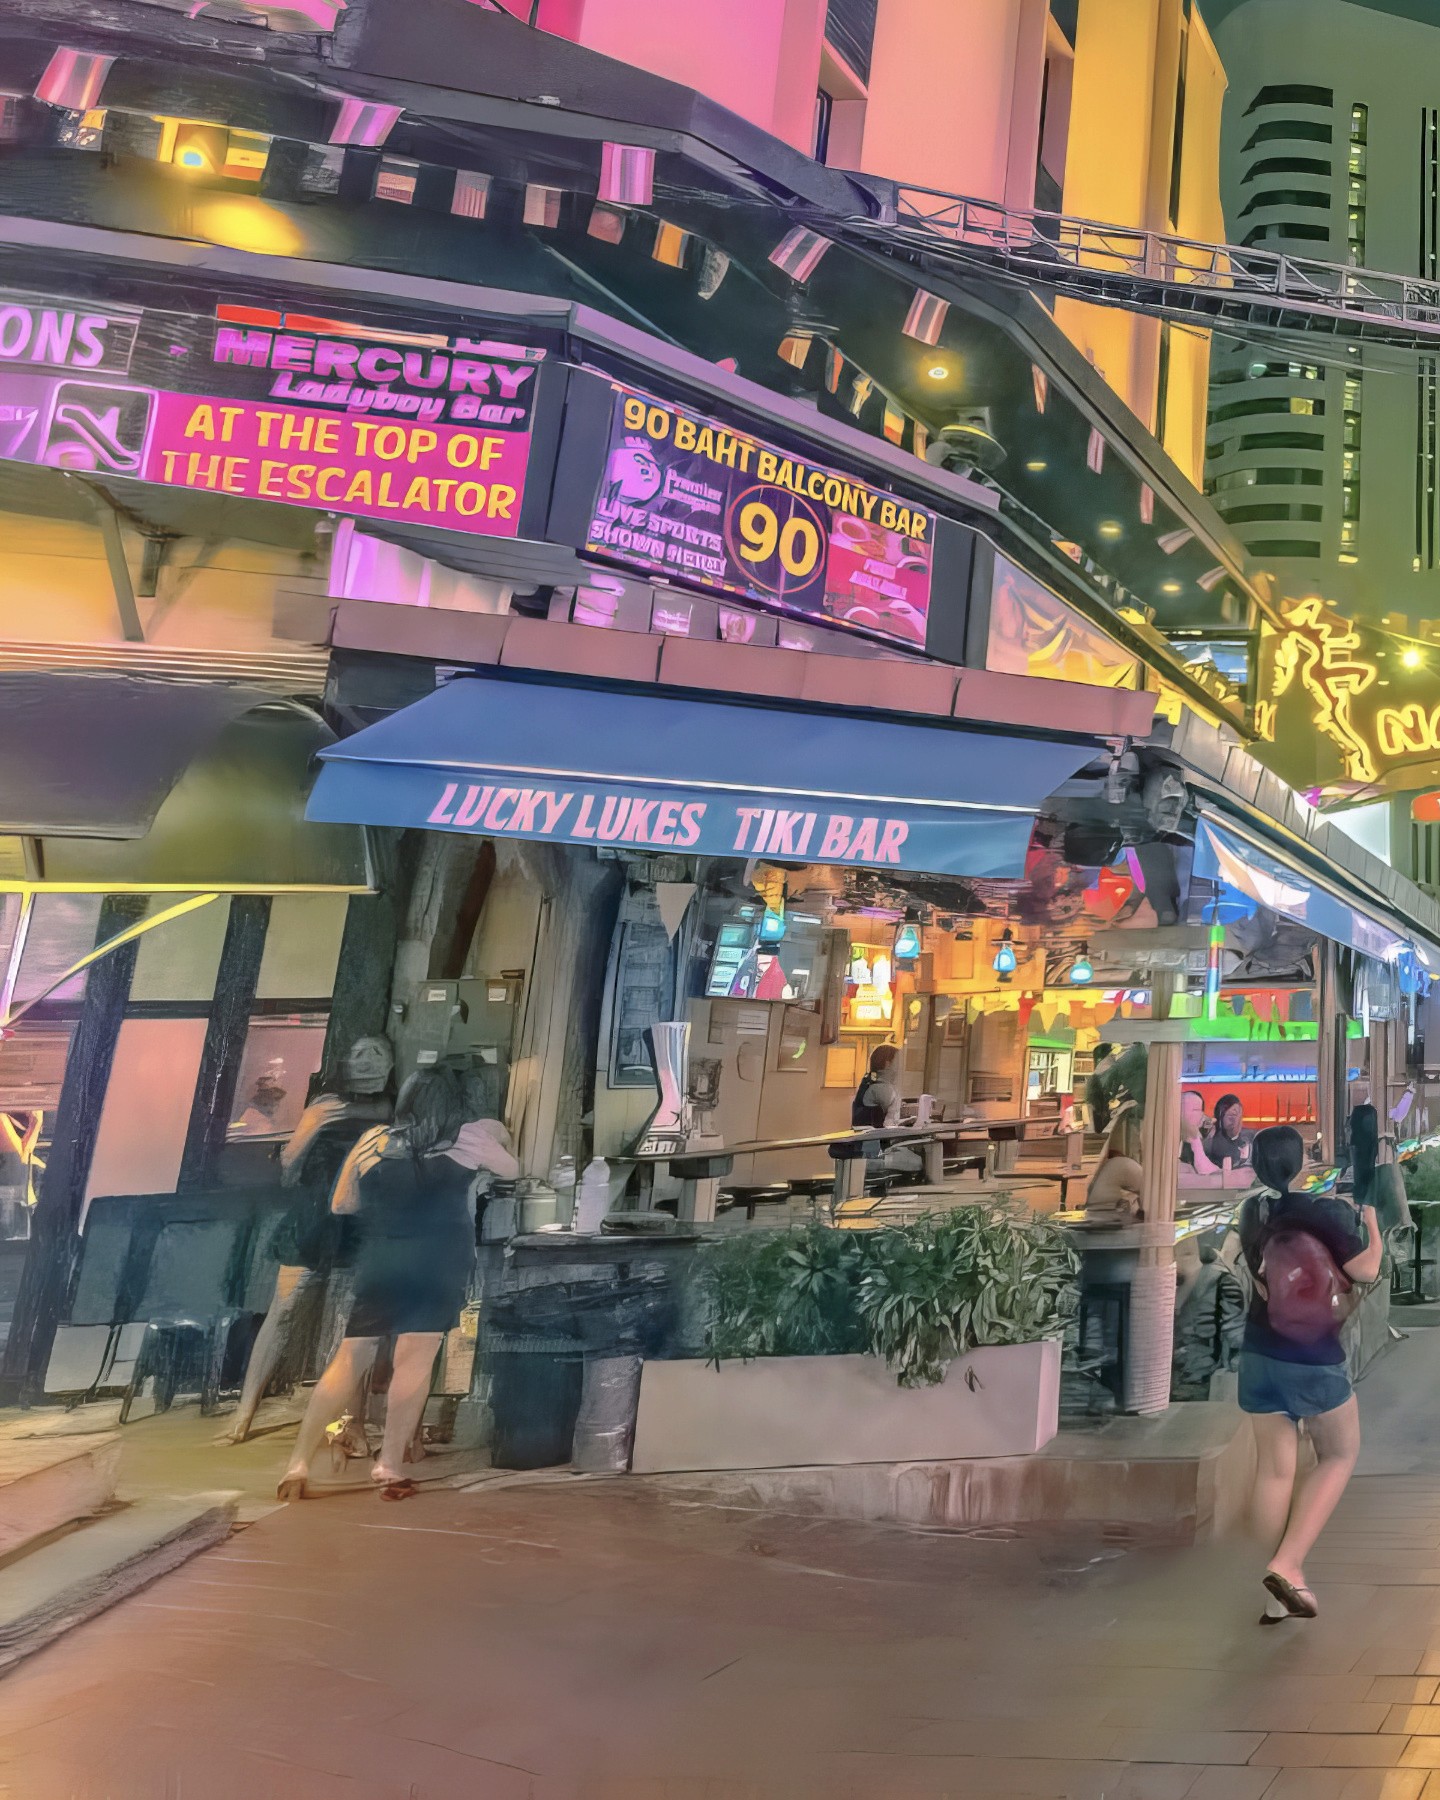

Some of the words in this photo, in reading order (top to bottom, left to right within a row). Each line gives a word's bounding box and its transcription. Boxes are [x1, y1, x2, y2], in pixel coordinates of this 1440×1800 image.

[213, 327, 535, 399] MERCURY
[184, 404, 243, 441] AT
[255, 411, 339, 453] THE
[352, 421, 438, 460] TOP
[446, 433, 505, 470] OF
[450, 394, 525, 424] Bar
[162, 450, 249, 492] THE
[257, 463, 518, 519] ESCALATOR
[623, 398, 669, 440] 90
[673, 416, 757, 473] BAHT
[757, 451, 880, 521] BALCONY
[880, 501, 928, 540] BAR
[739, 502, 819, 577] 90
[427, 783, 574, 833] LUCKY
[570, 795, 707, 846] LUKES
[732, 808, 817, 854] TIKI
[817, 817, 909, 863] BAR
